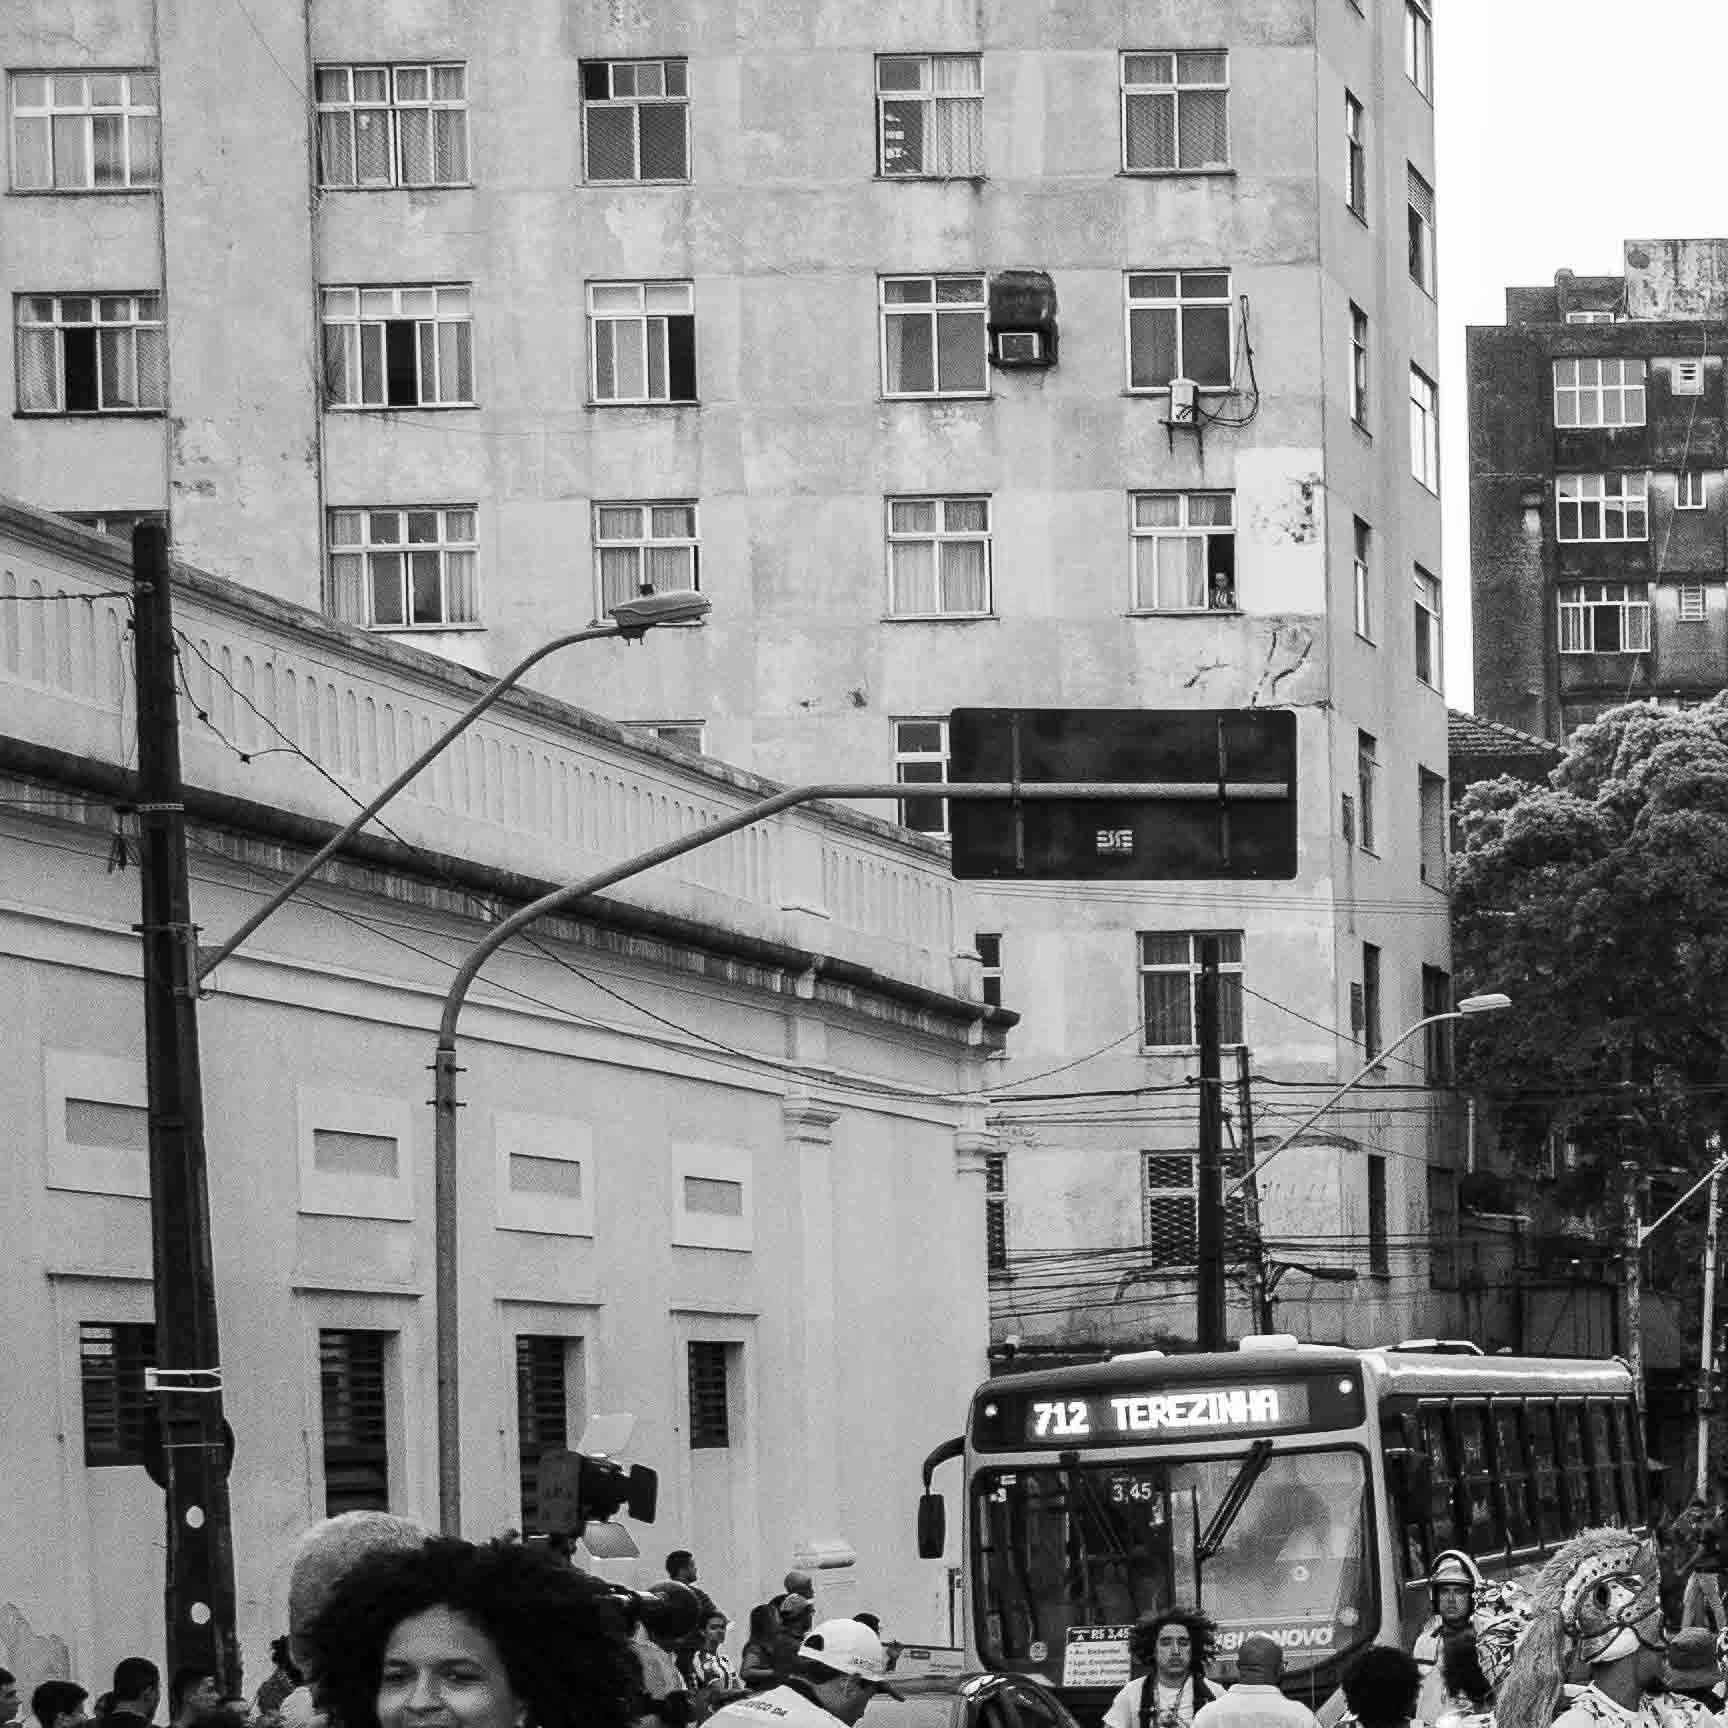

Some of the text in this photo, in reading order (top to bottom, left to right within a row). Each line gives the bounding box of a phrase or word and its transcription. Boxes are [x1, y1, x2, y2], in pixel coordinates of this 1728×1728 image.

[1033, 1389, 1279, 1435] 712 TEREZINHA
[1112, 1482, 1153, 1504] 3,45
